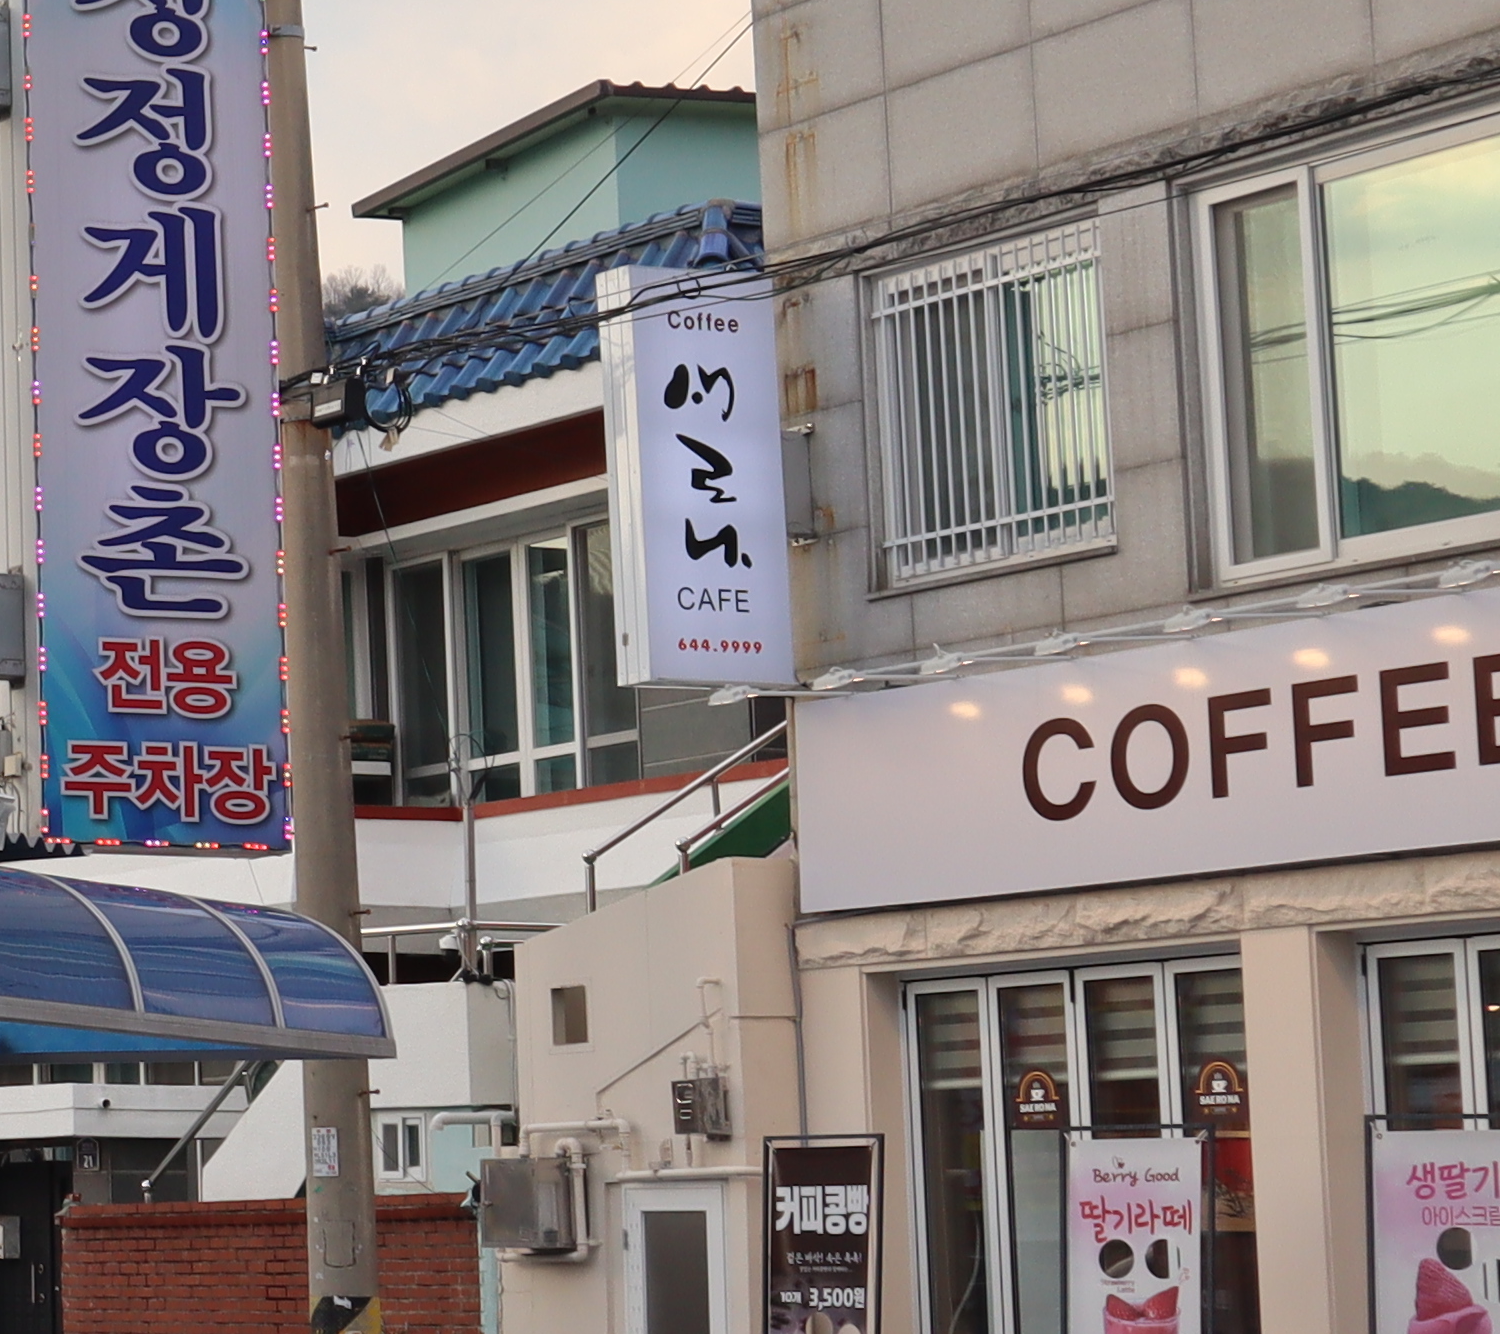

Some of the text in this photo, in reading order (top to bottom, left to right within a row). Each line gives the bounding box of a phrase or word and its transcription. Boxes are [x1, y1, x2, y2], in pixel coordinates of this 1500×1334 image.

[666, 310, 740, 335] Coffee
[677, 586, 751, 615] CAFE
[678, 637, 764, 655] 644.9999
[93, 638, 237, 720] 전용
[61, 740, 276, 826] 주차장
[1092, 1167, 1181, 1187] Berry Good
[1407, 1161, 1500, 1201] 생딸기
[776, 1184, 869, 1236] 커피콩빵
[1079, 1195, 1193, 1244] 딸기라떼
[808, 1286, 865, 1310] 3,500원
